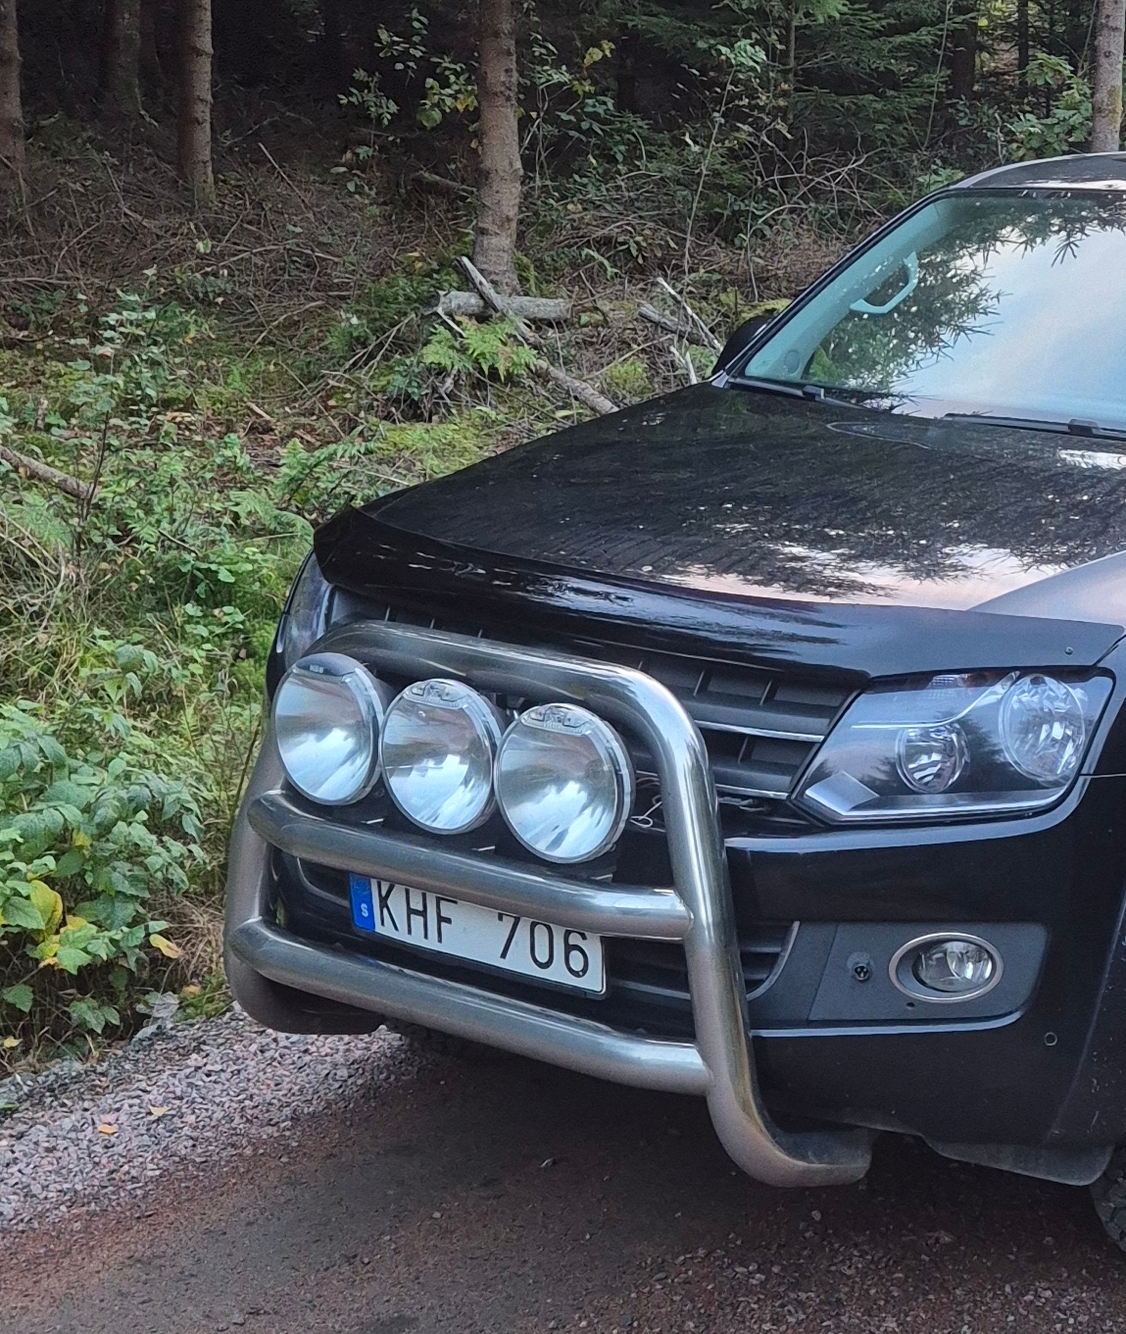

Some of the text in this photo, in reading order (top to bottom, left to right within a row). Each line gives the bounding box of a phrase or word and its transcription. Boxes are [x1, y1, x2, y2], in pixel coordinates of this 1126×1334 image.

[360, 902, 369, 918] S
[376, 880, 590, 979] KHF 706
